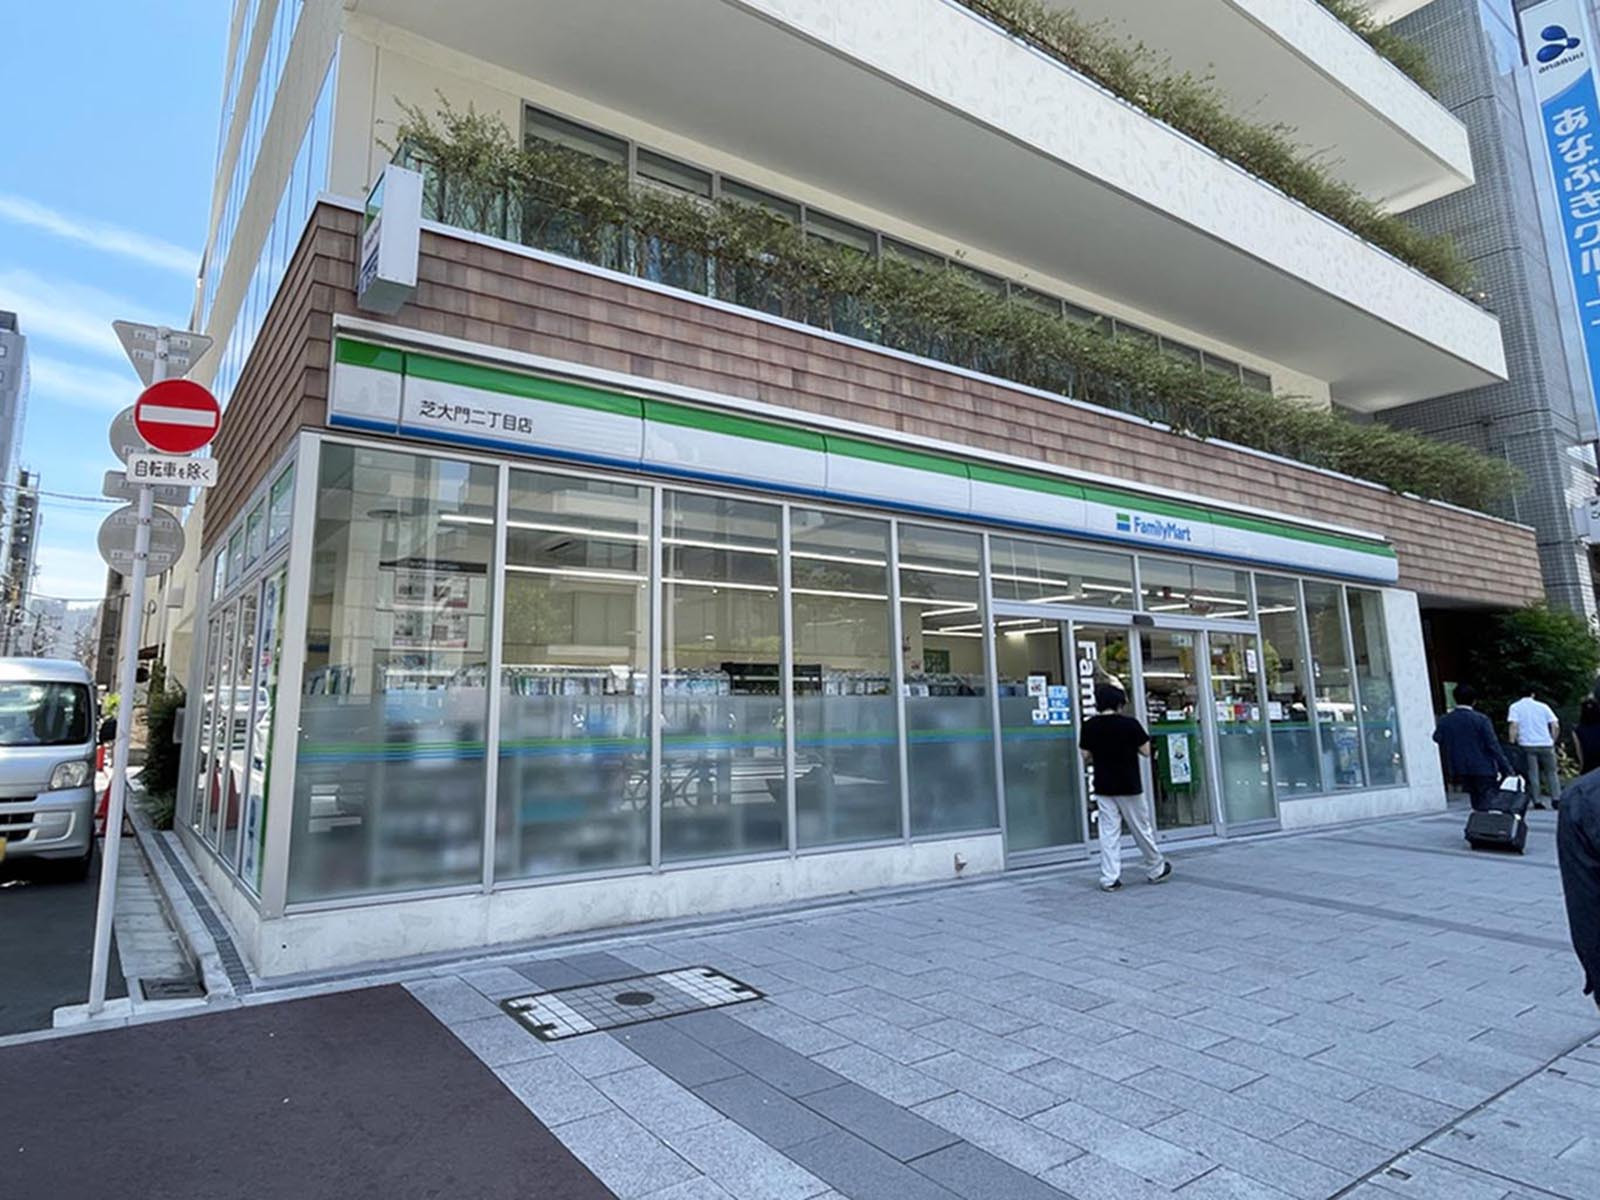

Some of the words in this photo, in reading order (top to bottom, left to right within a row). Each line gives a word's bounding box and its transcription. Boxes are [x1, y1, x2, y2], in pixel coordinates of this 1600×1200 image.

[420, 400, 533, 434] 芝大門二丁目店
[134, 460, 210, 480] 自転車を除く
[1133, 516, 1192, 541] FamilyMart
